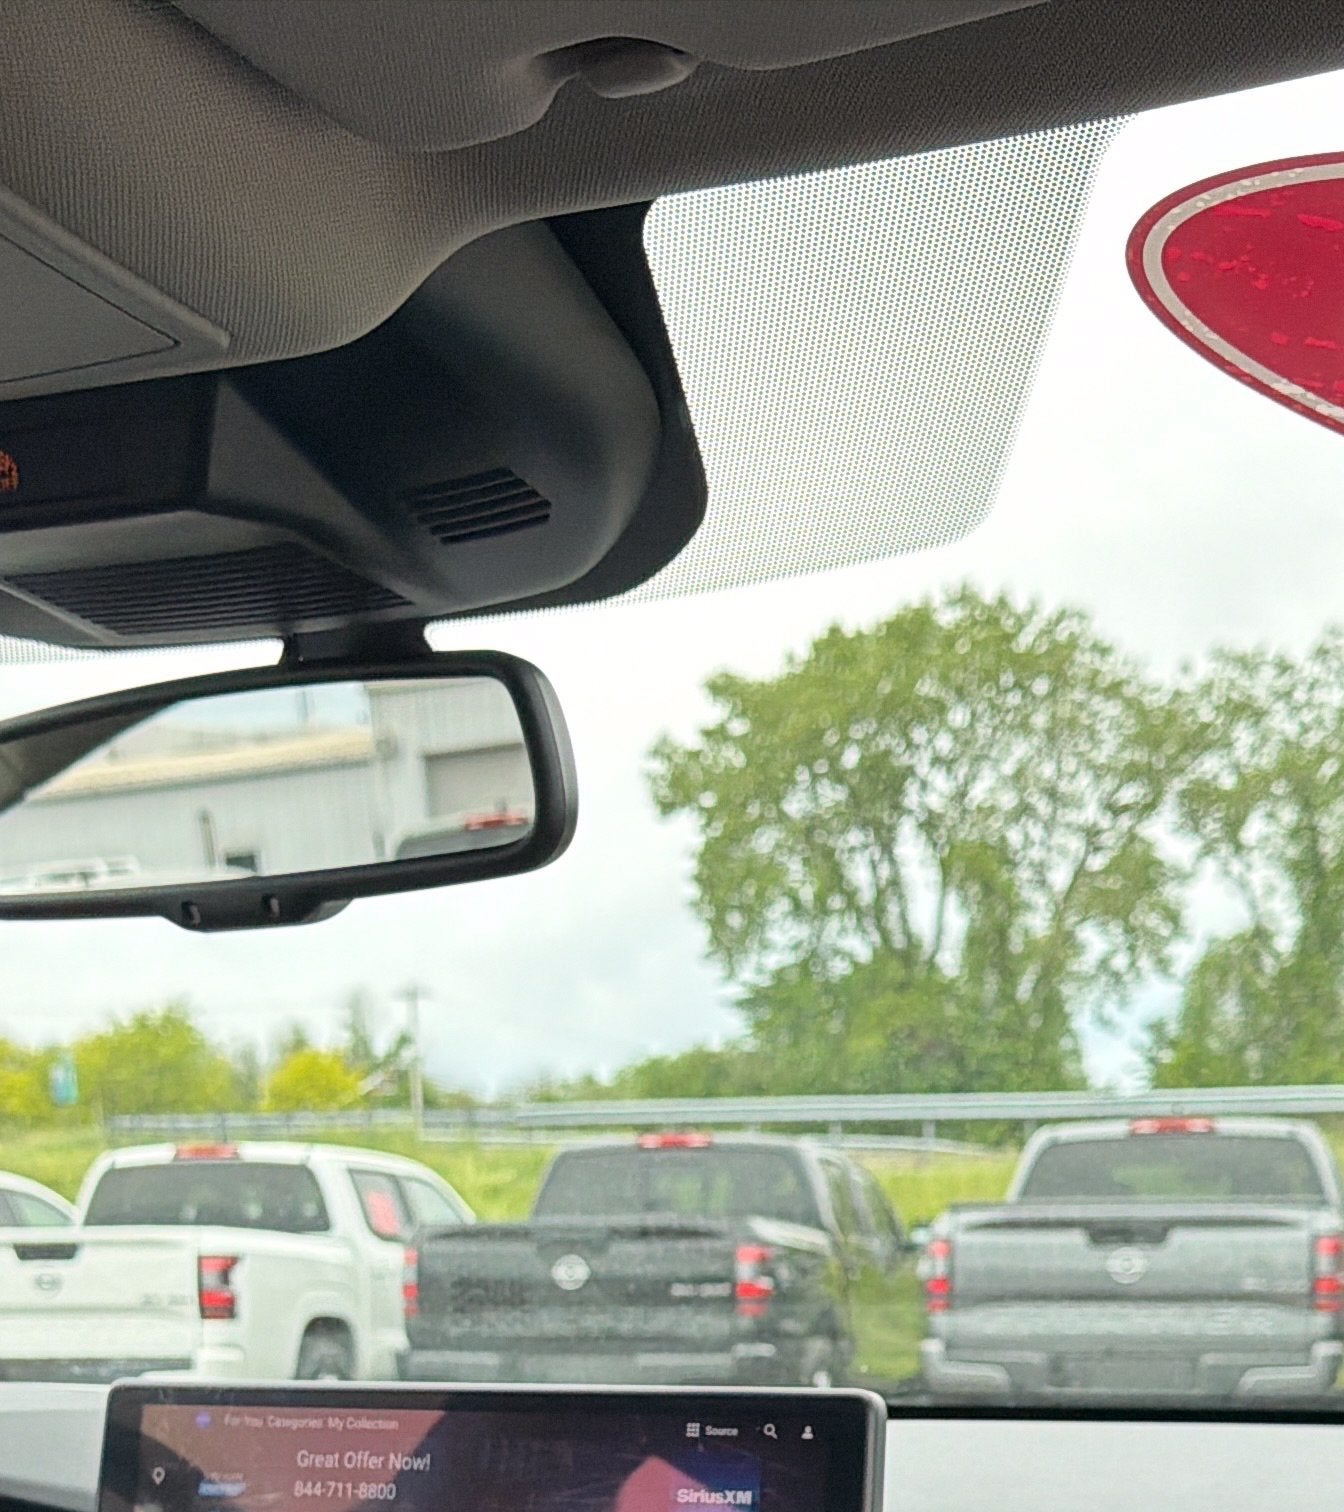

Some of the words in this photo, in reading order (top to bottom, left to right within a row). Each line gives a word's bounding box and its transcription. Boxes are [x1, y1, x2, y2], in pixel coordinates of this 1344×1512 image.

[296, 1450, 339, 1468] Great
[343, 1451, 384, 1469] Offer
[388, 1453, 431, 1471] Now!
[293, 1480, 397, 1500] 844-711-8800
[676, 1488, 753, 1506] SiriusXM
